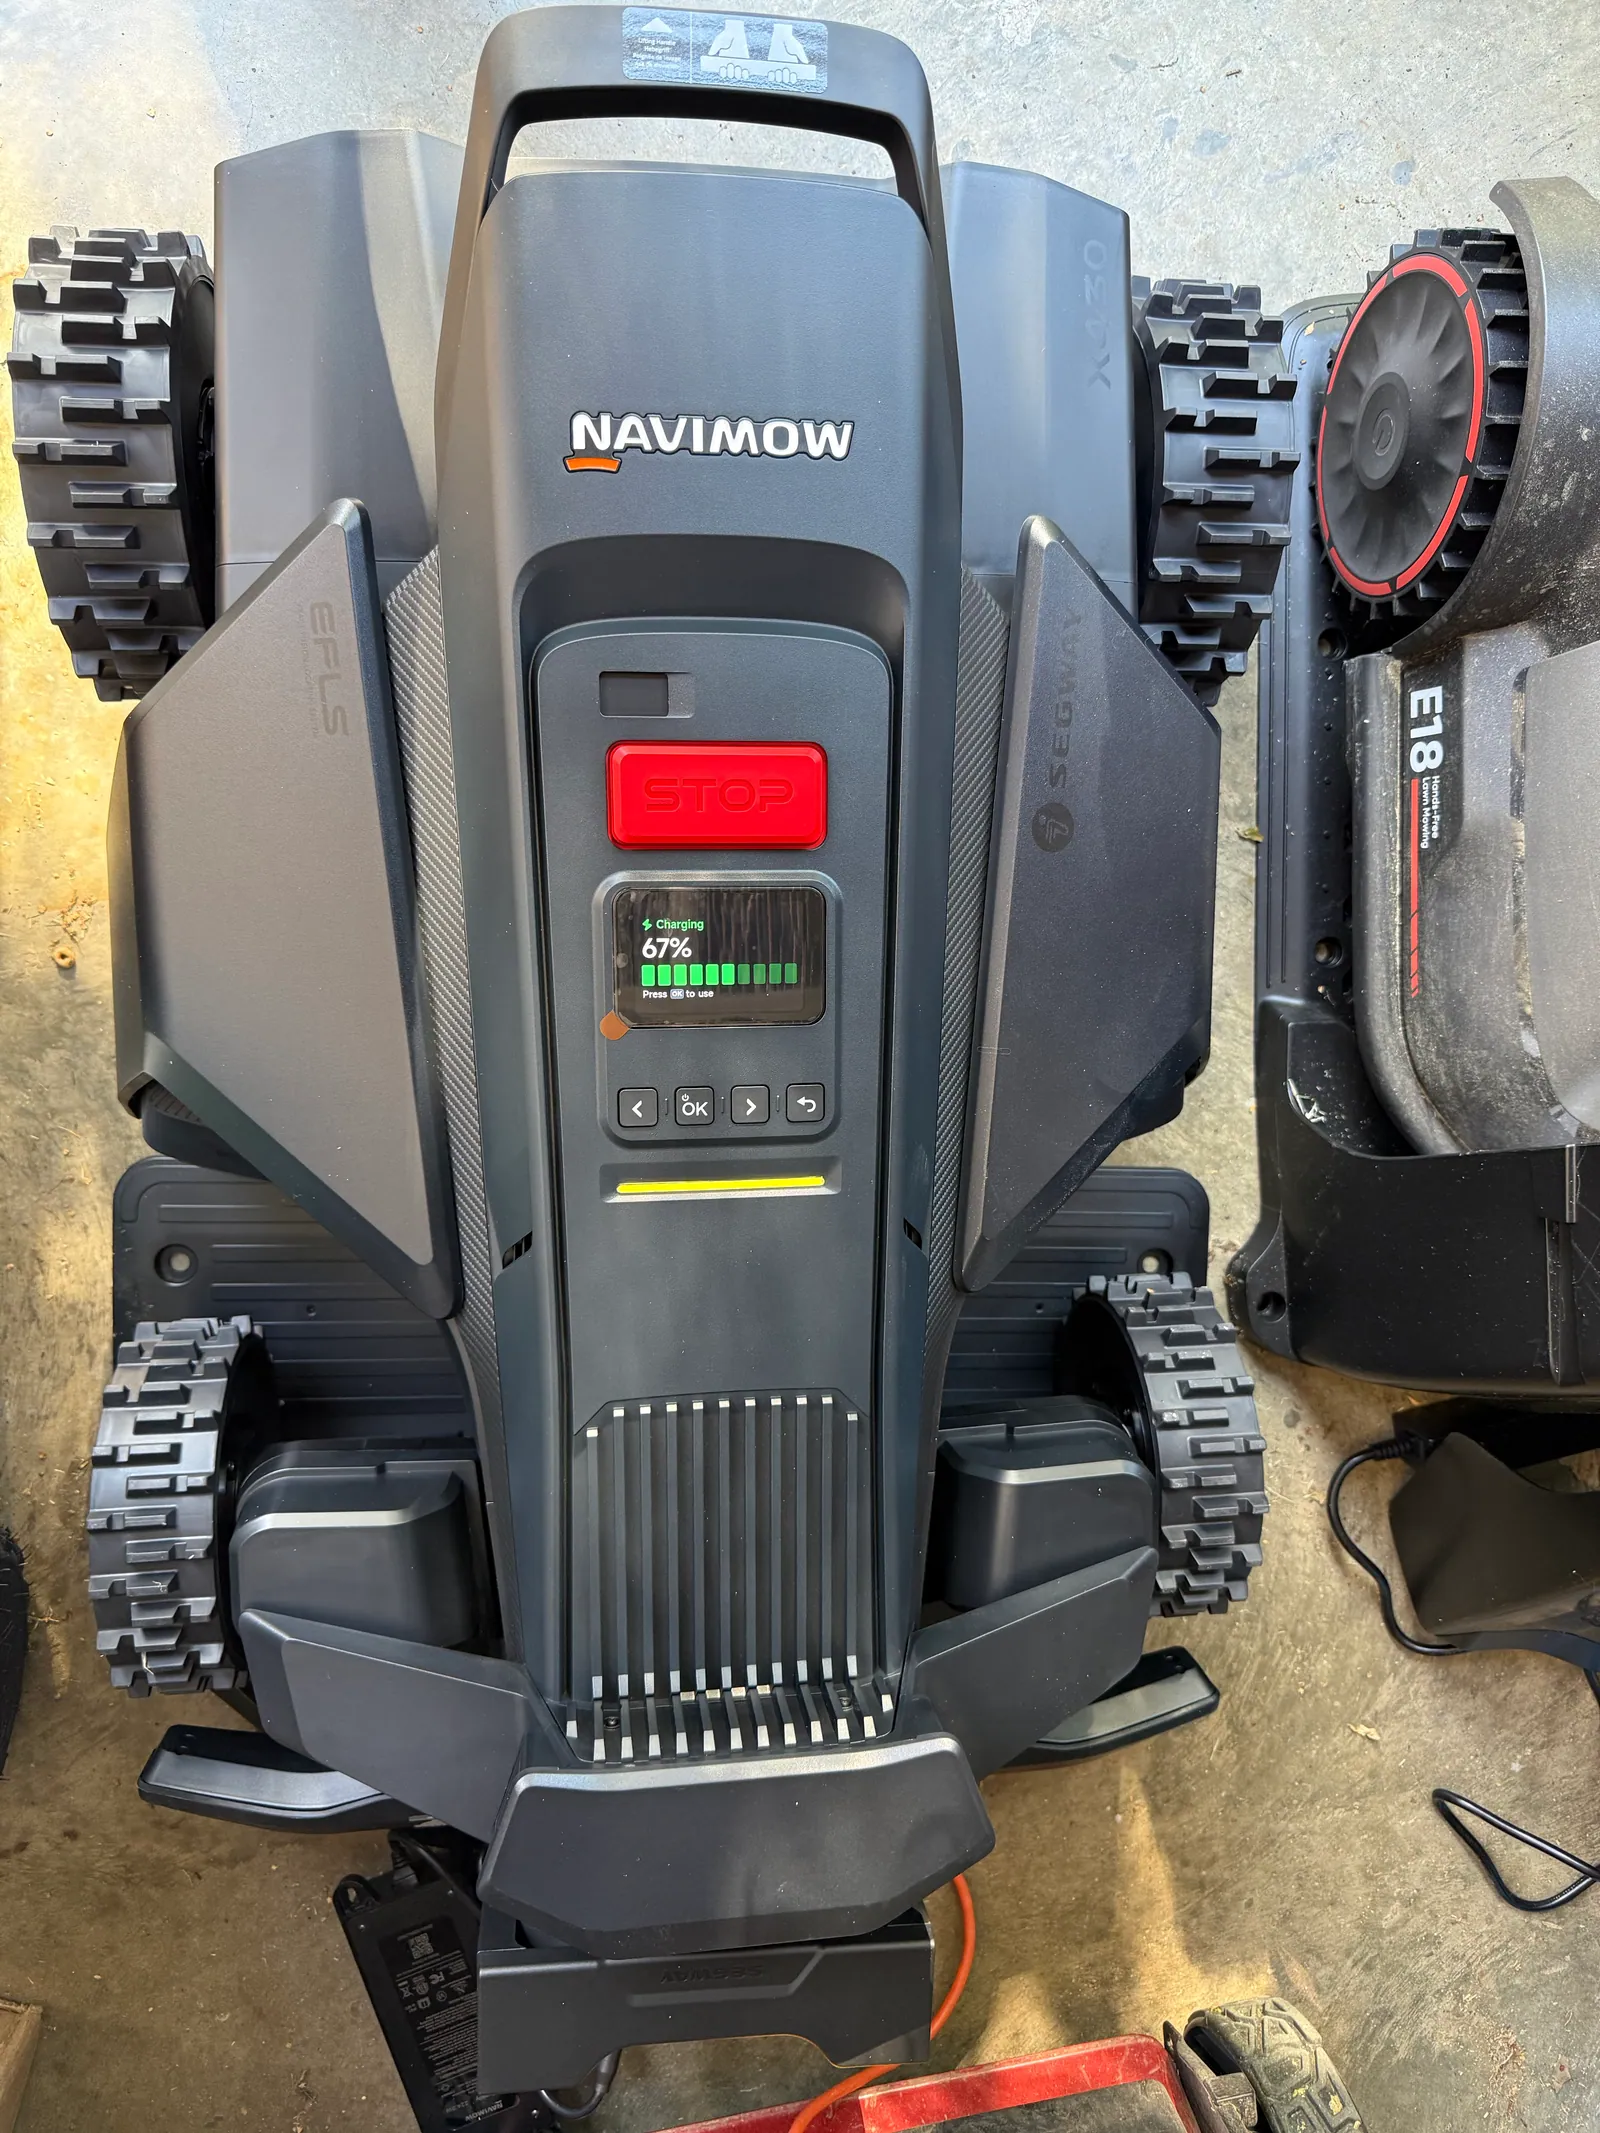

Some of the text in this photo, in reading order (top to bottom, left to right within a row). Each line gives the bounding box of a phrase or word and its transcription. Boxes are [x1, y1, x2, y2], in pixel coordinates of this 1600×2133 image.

[571, 412, 853, 459] NAVIMOW
[310, 601, 350, 736] EFLS
[1050, 611, 1082, 789] SEGWAY
[1410, 685, 1444, 773] E18
[644, 778, 795, 814] STOP
[1420, 776, 1431, 849] Lawn Mowing
[1431, 775, 1441, 839] Hands-Free
[656, 919, 704, 931] Charging
[642, 937, 692, 958] 67%
[642, 989, 714, 999] Press OK to use
[681, 1101, 709, 1117] OK
[465, 2103, 503, 2121] NAVIMOW
